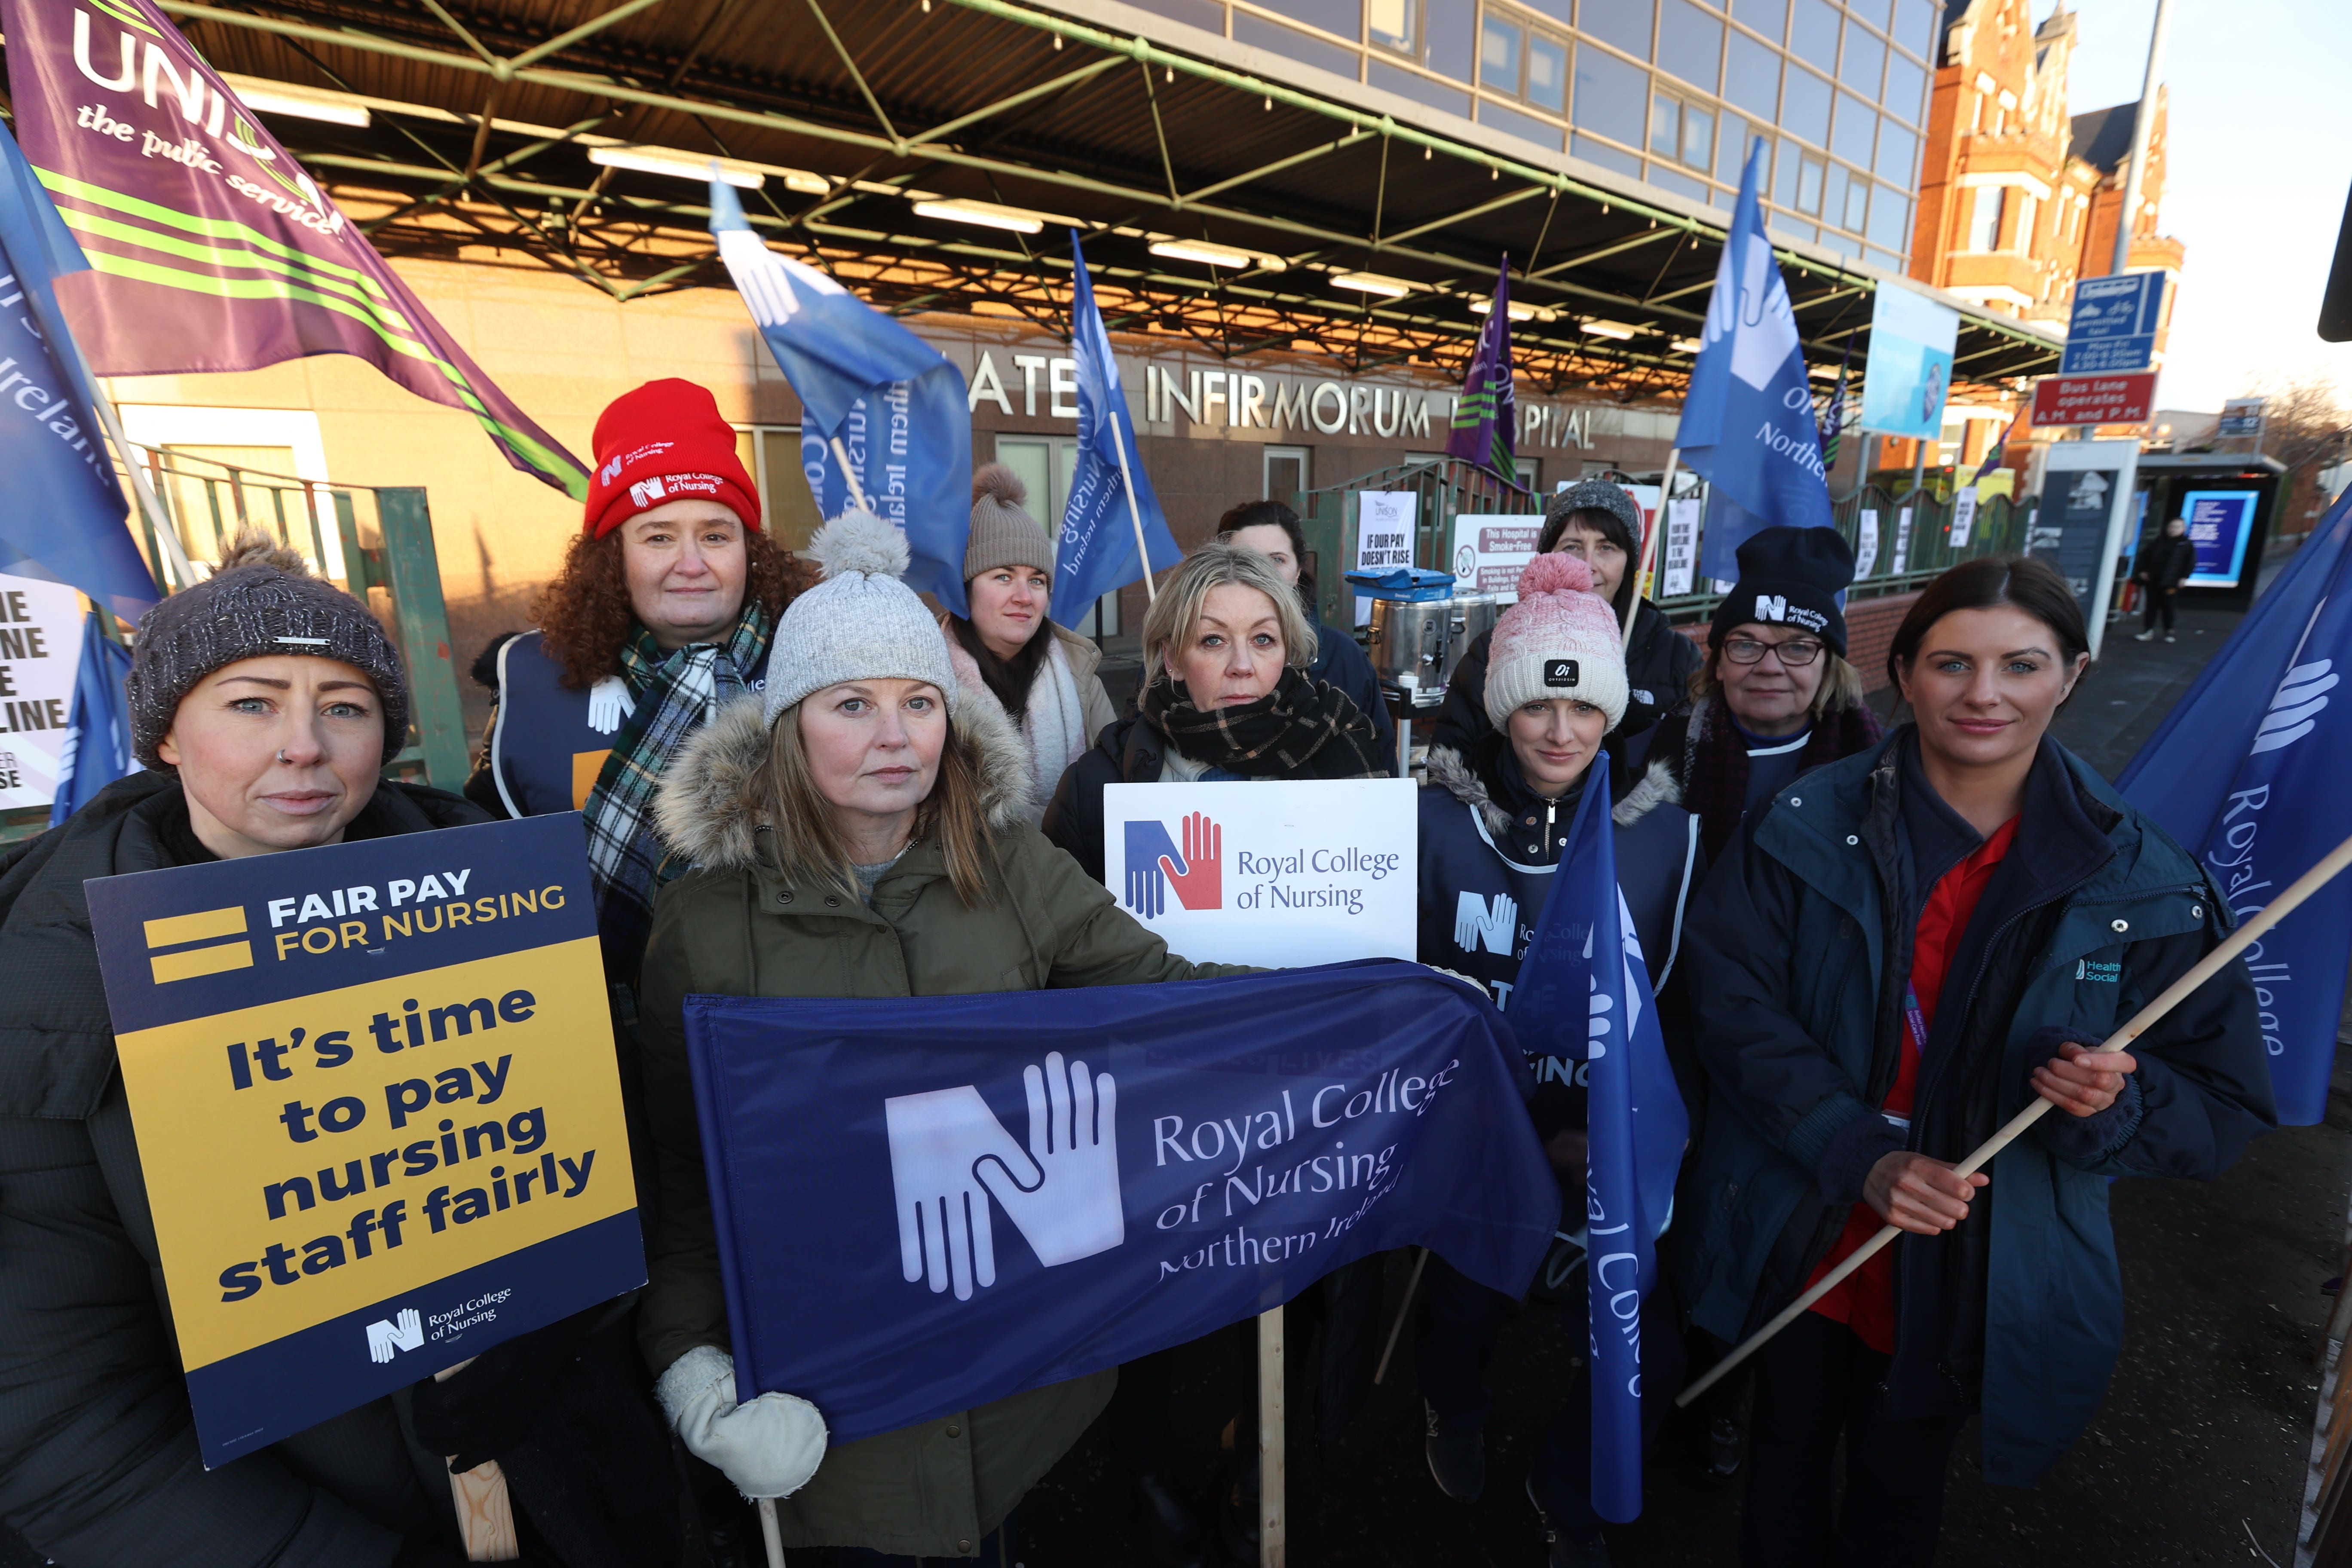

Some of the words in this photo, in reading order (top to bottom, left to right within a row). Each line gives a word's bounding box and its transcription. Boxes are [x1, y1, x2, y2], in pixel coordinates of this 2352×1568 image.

[77, 104, 134, 142] the
[2058, 381, 2089, 395] Bus
[1146, 364, 1431, 439] INFIRMORUM
[2057, 393, 2126, 407] operates
[2073, 409, 2104, 421] and
[665, 473, 692, 485] Royal
[692, 472, 724, 485] College
[668, 483, 679, 493] of
[679, 481, 717, 494] Nursing
[1375, 506, 1398, 516] UNISON
[1367, 533, 1373, 548] IF
[1374, 533, 1389, 548] OUR
[1390, 533, 1405, 548] PAY
[1486, 529, 1500, 539] This
[1502, 528, 1529, 540] Hospital
[1531, 530, 1537, 538] is
[1488, 541, 1532, 551] Smoke-Free
[1361, 550, 1391, 566] DOESN'T
[1392, 549, 1410, 564] RISE
[1480, 567, 1501, 576] Smoking
[1786, 615, 1797, 623] of
[1796, 616, 1822, 633] Nursing
[1788, 605, 1810, 616] Royal
[1809, 610, 1828, 627] College
[1238, 848, 1305, 884] Royal
[1311, 847, 1399, 880] College
[267, 886, 379, 928] FAIR
[389, 868, 472, 907] PAY
[1237, 884, 1263, 909] of
[1271, 883, 1364, 915] Nursing
[273, 921, 370, 962] FOR
[383, 885, 566, 940] NURSING
[2086, 971, 2118, 983] Social
[2087, 961, 2122, 971] Health
[367, 989, 536, 1054] time
[1907, 1010, 1916, 1025] Social
[279, 1095, 366, 1143] to
[384, 1054, 512, 1130] pay
[1152, 1090, 1295, 1177] Royal
[1311, 1059, 1460, 1129] College
[262, 1106, 548, 1221] nursing
[1156, 1182, 1214, 1230] of
[1225, 1141, 1398, 1217] Nursing
[218, 1199, 407, 1303] staff
[421, 1148, 597, 1235] fairly
[1158, 1225, 1317, 1283] Northern
[1323, 1163, 1404, 1240] Ireland
[428, 1303, 464, 1327] Royal
[466, 1287, 512, 1311] College
[431, 1326, 445, 1341] of
[448, 1308, 497, 1335] Nursing
